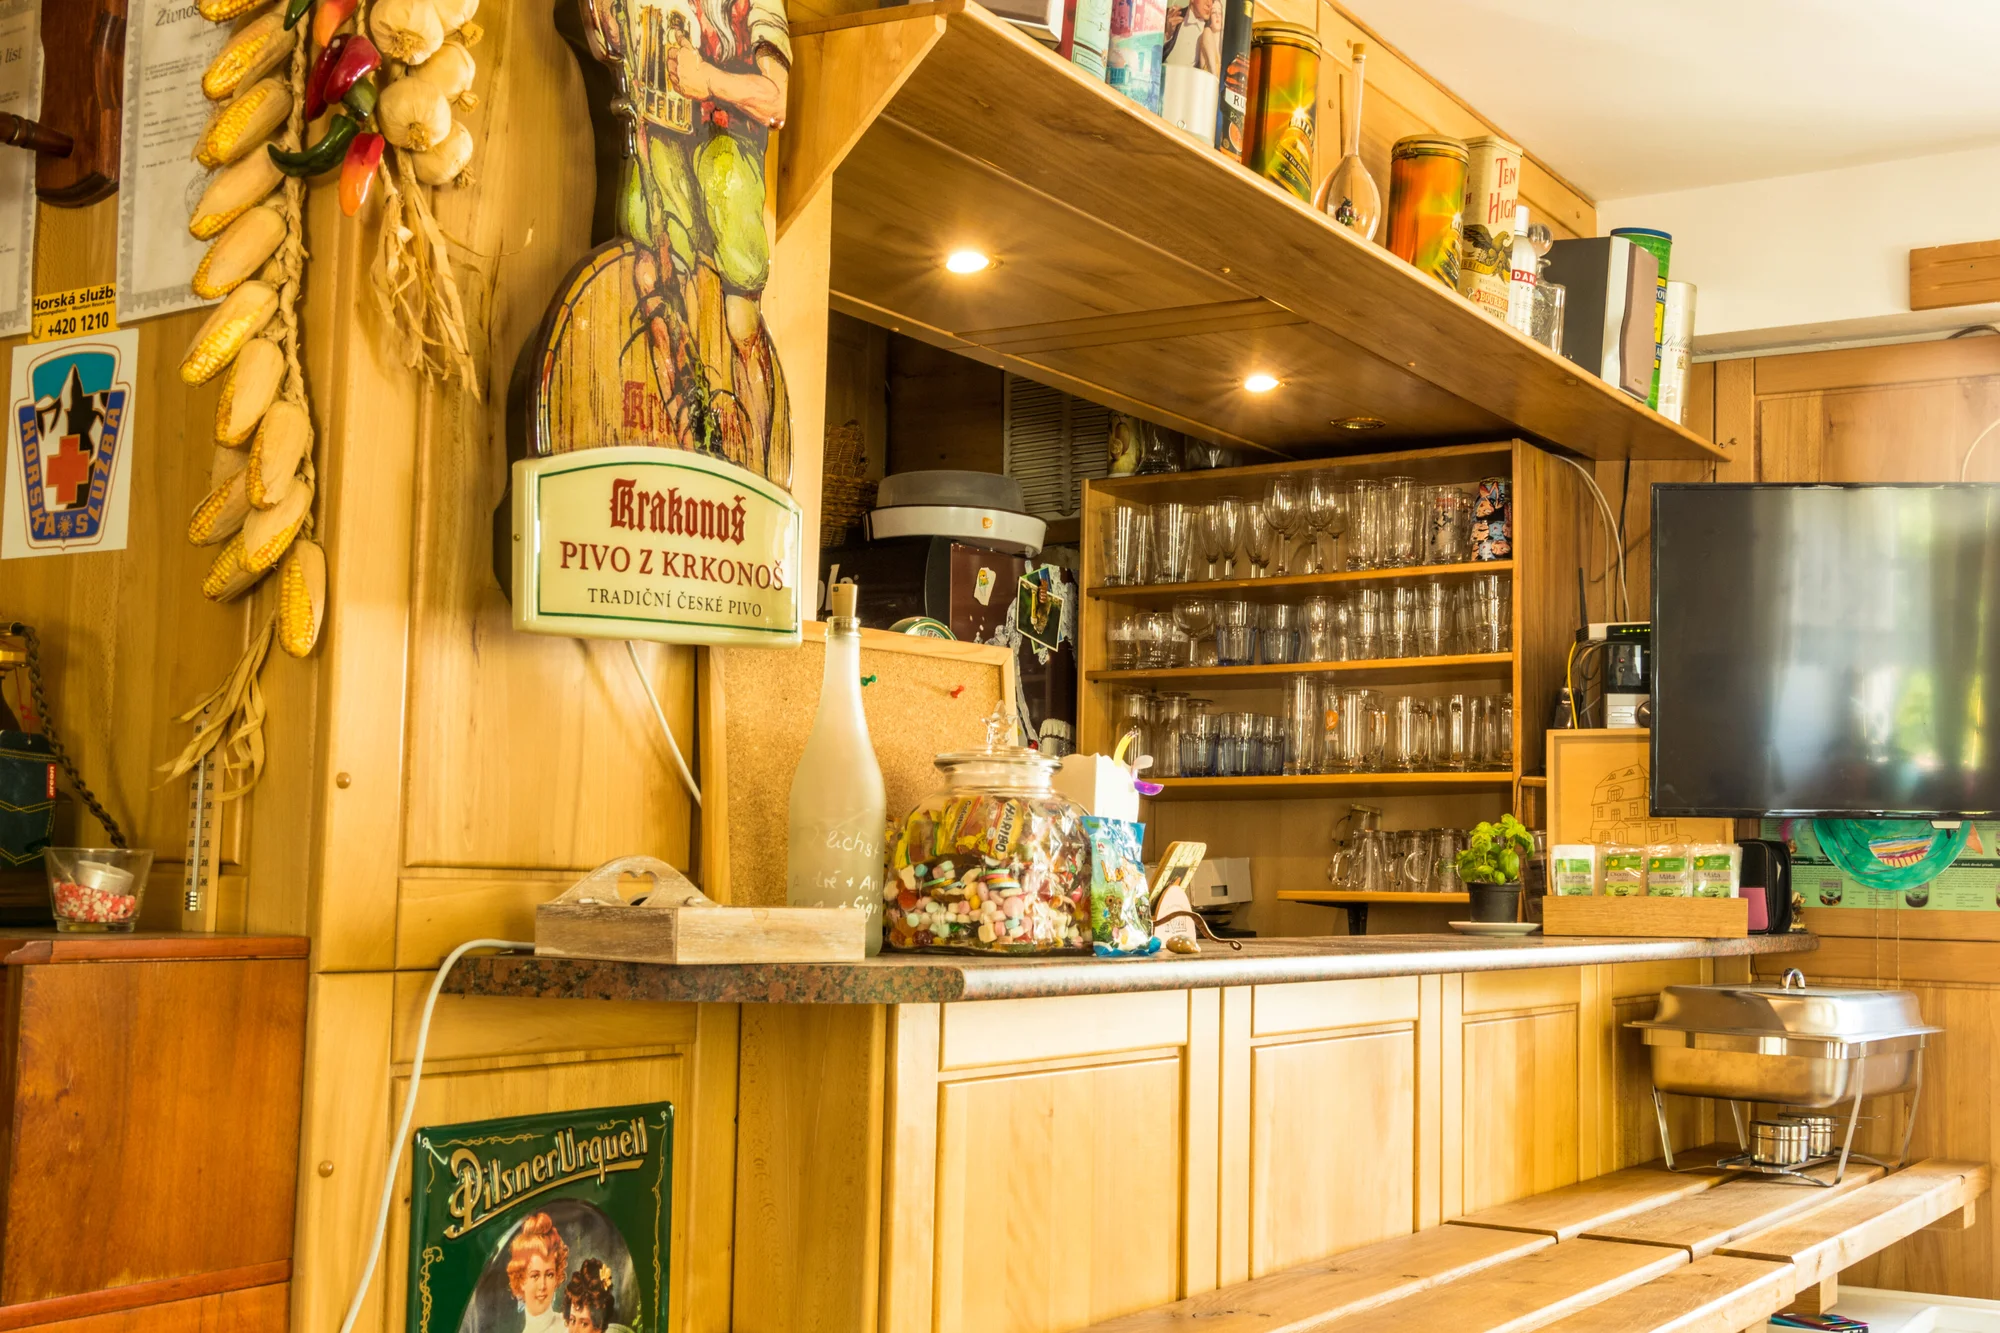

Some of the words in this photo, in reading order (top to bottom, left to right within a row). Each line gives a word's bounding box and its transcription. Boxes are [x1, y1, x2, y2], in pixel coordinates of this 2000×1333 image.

[156, 3, 200, 27] Živnos
[5, 46, 22, 63] list
[1514, 270, 1536, 284] DAN
[34, 292, 76, 311] Horská
[48, 316, 77, 337] +420
[81, 311, 109, 332] 1210
[609, 477, 747, 546] Krakonoš
[559, 540, 631, 574] PIVO
[639, 548, 654, 575] Z
[662, 551, 785, 592] KRKONOŠ
[588, 587, 671, 608] TRADIČNÍ
[677, 591, 724, 613] ČESKÉ
[728, 600, 763, 618] PIVO
[995, 802, 1016, 852] HARIBO
[449, 1147, 558, 1234] Pilsner
[556, 1115, 649, 1184] Urquell
